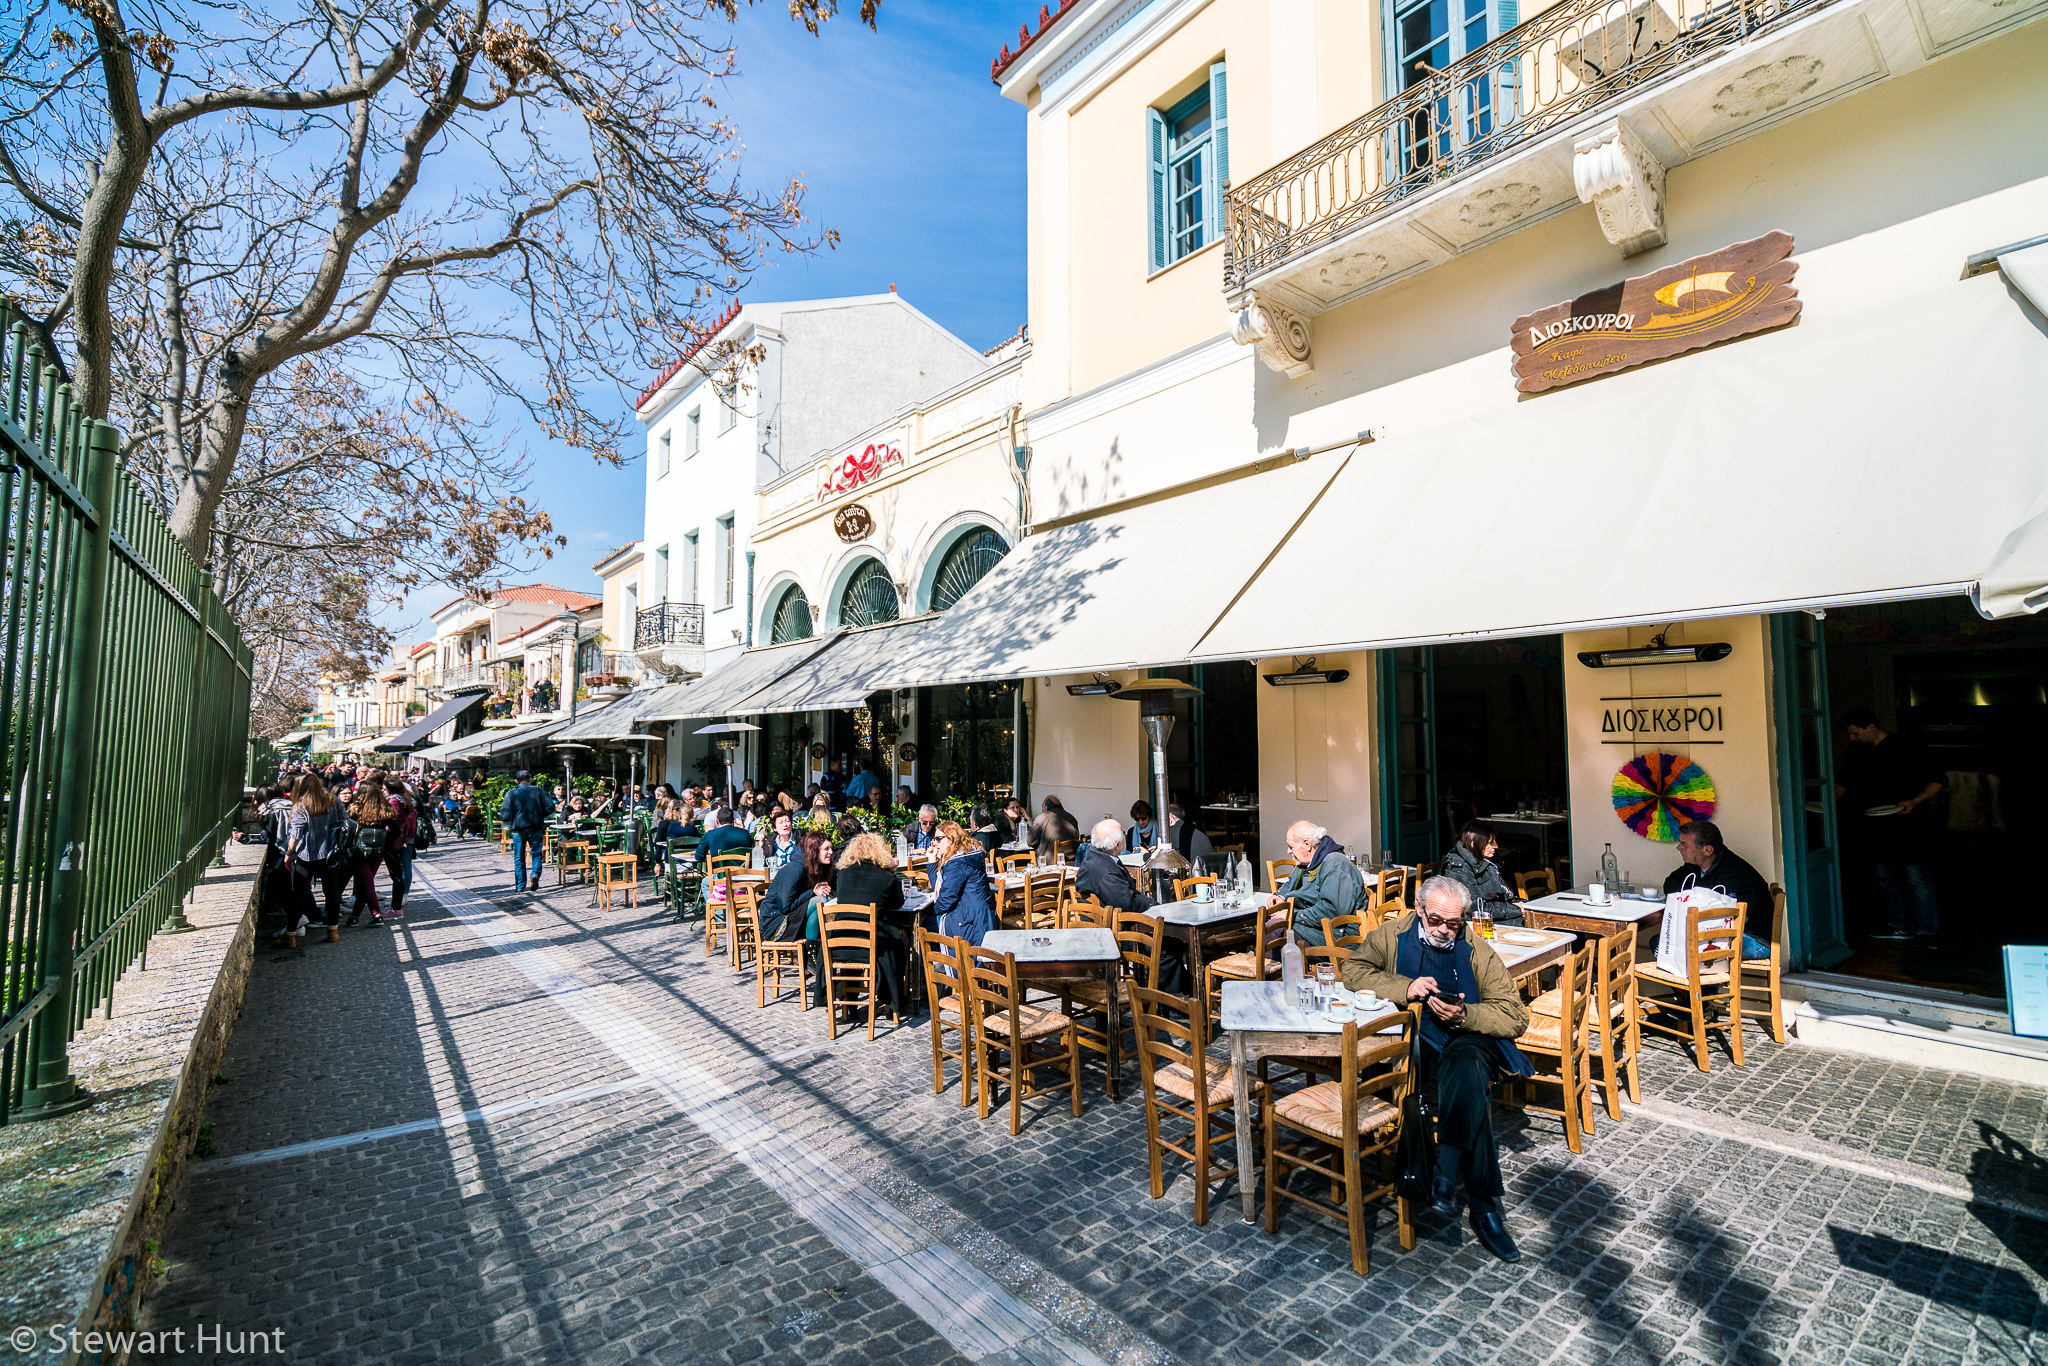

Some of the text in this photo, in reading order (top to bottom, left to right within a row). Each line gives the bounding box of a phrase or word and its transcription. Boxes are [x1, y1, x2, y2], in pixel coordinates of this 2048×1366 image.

[1529, 313, 1635, 348] ΔΙΟΣΚΟΥΡΟΙ
[1539, 353, 1627, 382] Μεζεδοπωλείο
[1548, 344, 1585, 363] Καφέ
